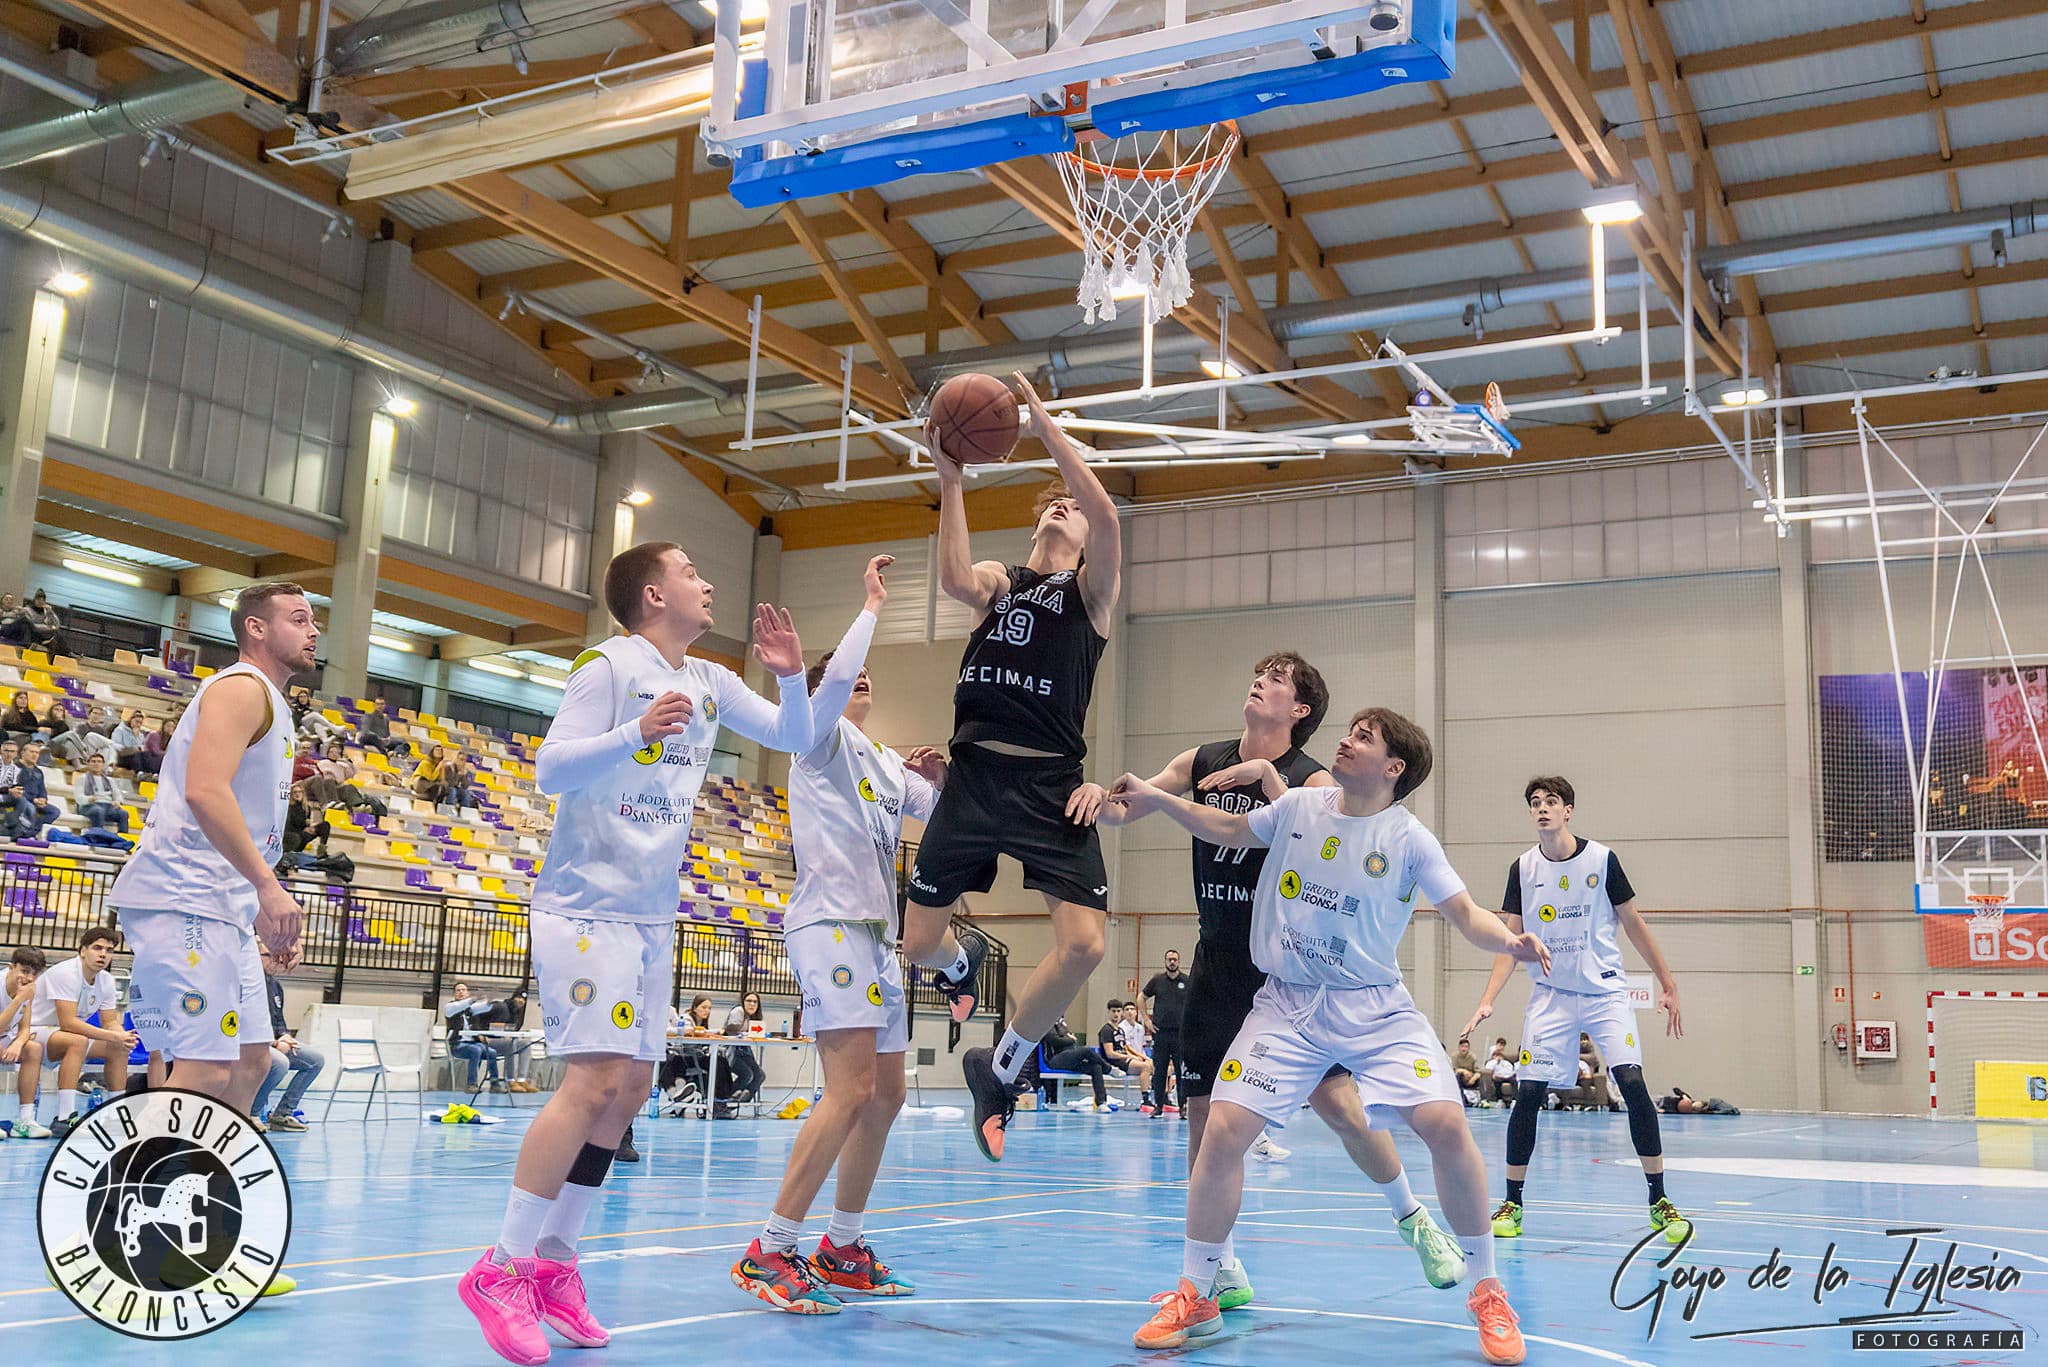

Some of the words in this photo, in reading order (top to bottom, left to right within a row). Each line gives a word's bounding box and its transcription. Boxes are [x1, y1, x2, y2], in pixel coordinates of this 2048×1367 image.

[986, 608, 1034, 647] 19
[958, 666, 1052, 696] ECIMAS
[1320, 836, 1341, 861] 6
[1303, 881, 1339, 900] GRUPO
[1559, 875, 1569, 891] 4
[1301, 892, 1338, 912] LEONSA
[1245, 1066, 1279, 1085] GRUPO
[1413, 1059, 1432, 1079] 6
[1242, 1074, 1278, 1095] LEONSA
